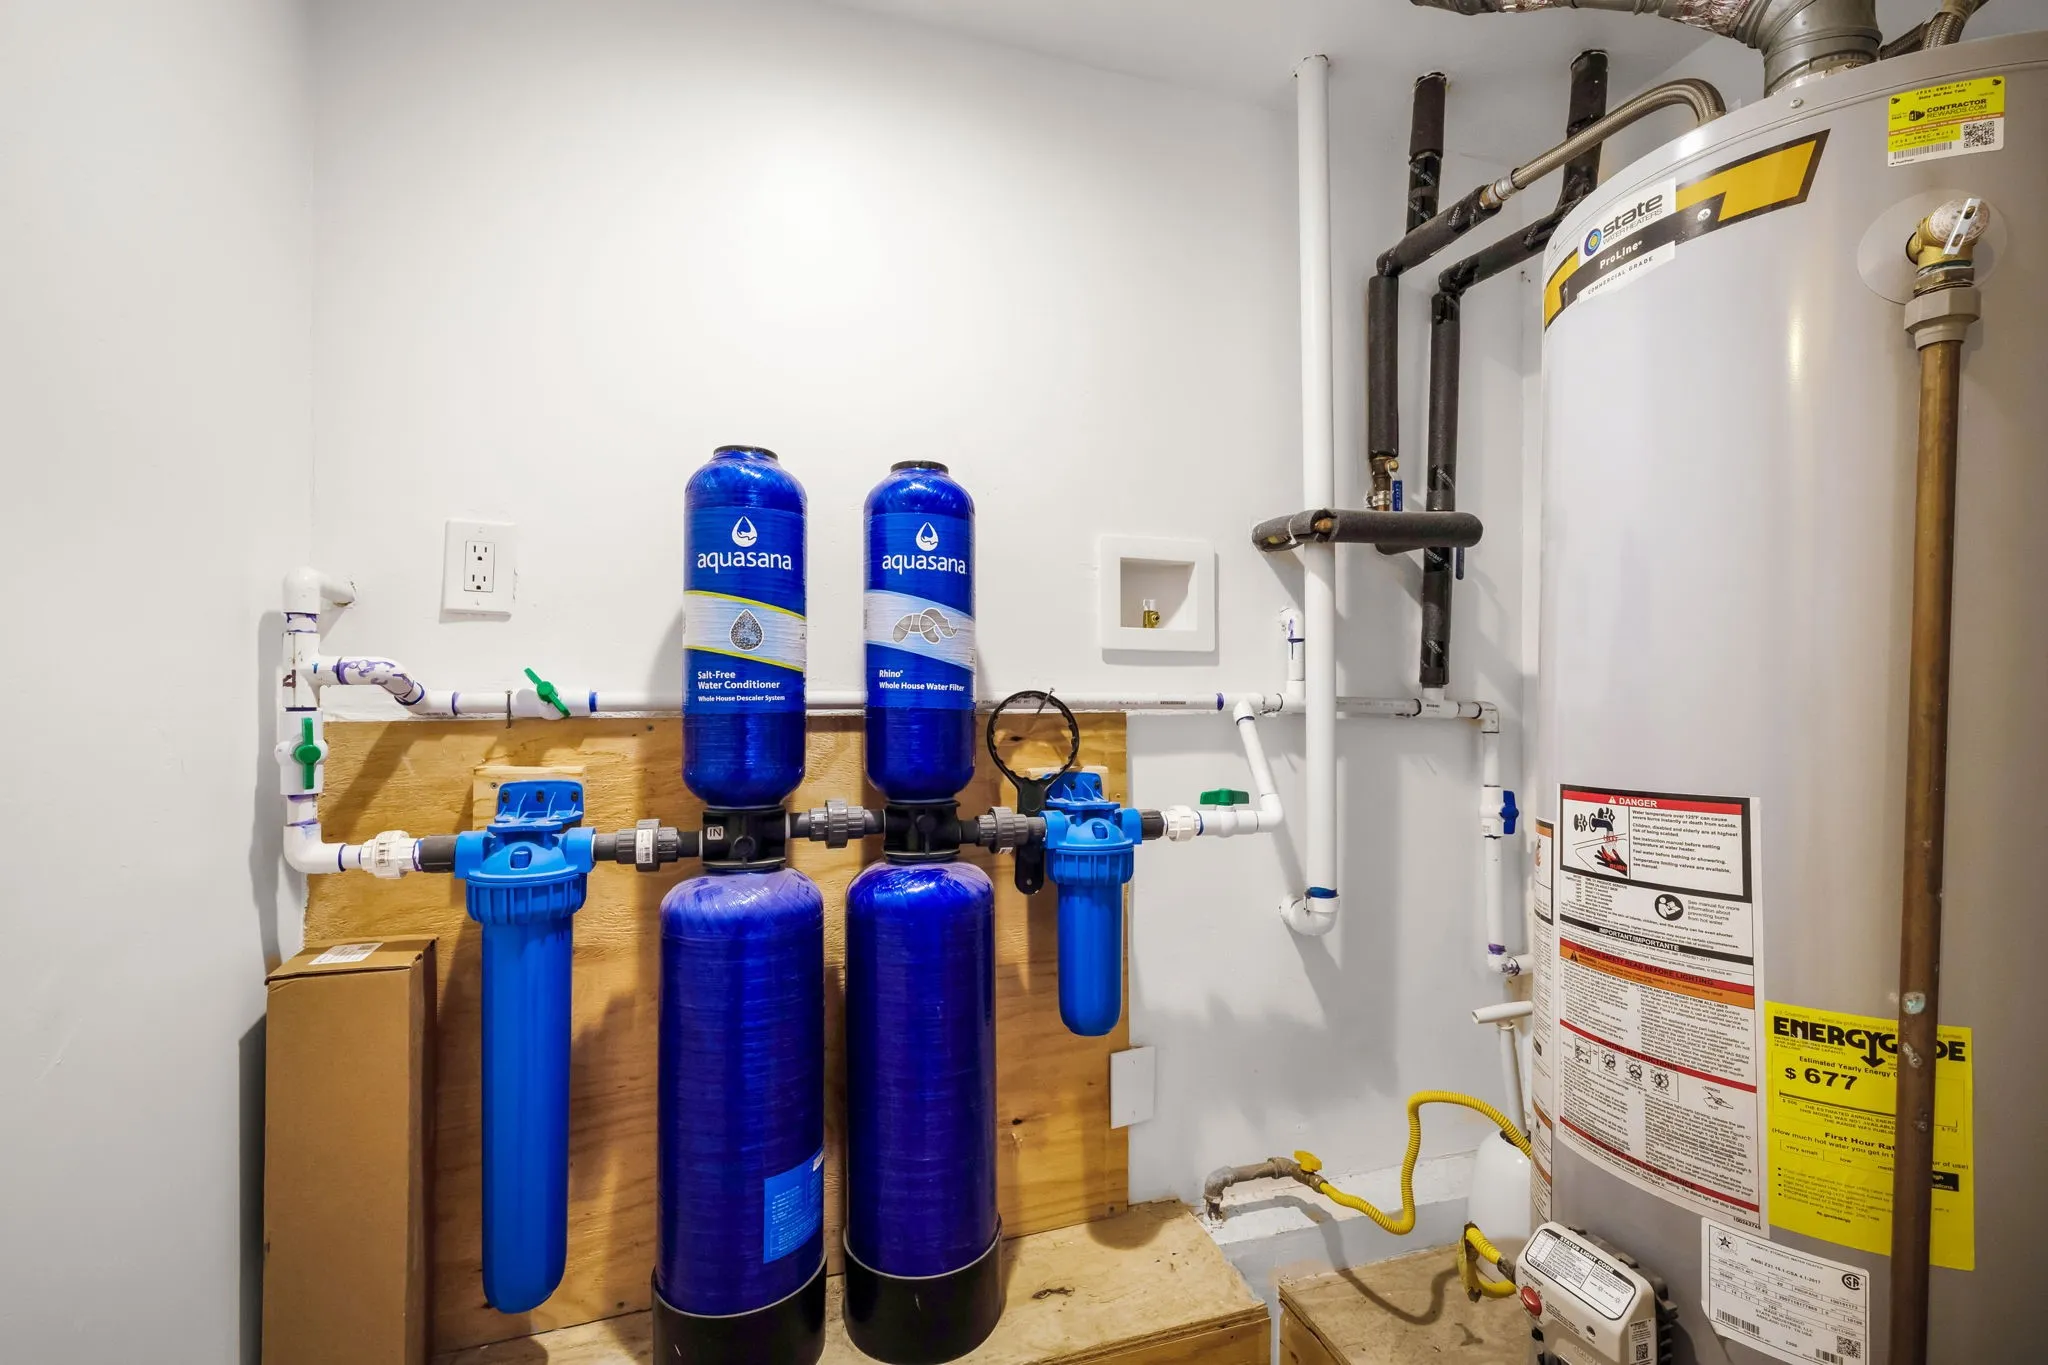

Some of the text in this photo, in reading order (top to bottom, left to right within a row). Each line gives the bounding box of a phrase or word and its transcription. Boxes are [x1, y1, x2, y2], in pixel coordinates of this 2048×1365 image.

[1927, 98, 1987, 112] CONTRACTOR
[1603, 194, 1663, 238] state
[1603, 208, 1663, 244] WATER HEATERS
[1588, 256, 1654, 294] COMMERCIAL GRADE
[697, 551, 792, 574] aquasana
[882, 554, 966, 576] aquasana
[697, 680, 780, 690] Water Conditioner
[698, 670, 736, 680] Salt-Free
[901, 682, 925, 690] House
[926, 682, 948, 690] Water
[949, 684, 965, 692] Filter
[1619, 798, 1657, 808] DANGER
[708, 828, 722, 837] IN
[1676, 971, 1714, 986] LIGHTING
[1774, 1016, 1965, 1062] ENERGYGDE
[1800, 1056, 1890, 1078] Estimated Yearly Energy
[1785, 1068, 1858, 1090] $ 677
[1792, 1130, 1812, 1142] much
[1814, 1138, 1826, 1146] hot
[1828, 1140, 1850, 1150] water
[1851, 1144, 1866, 1152] you
[1868, 1147, 1880, 1156] get
[1824, 1132, 1896, 1151] First Hour Rat
[1560, 1236, 1614, 1274] STATUS LIGHT CODE
